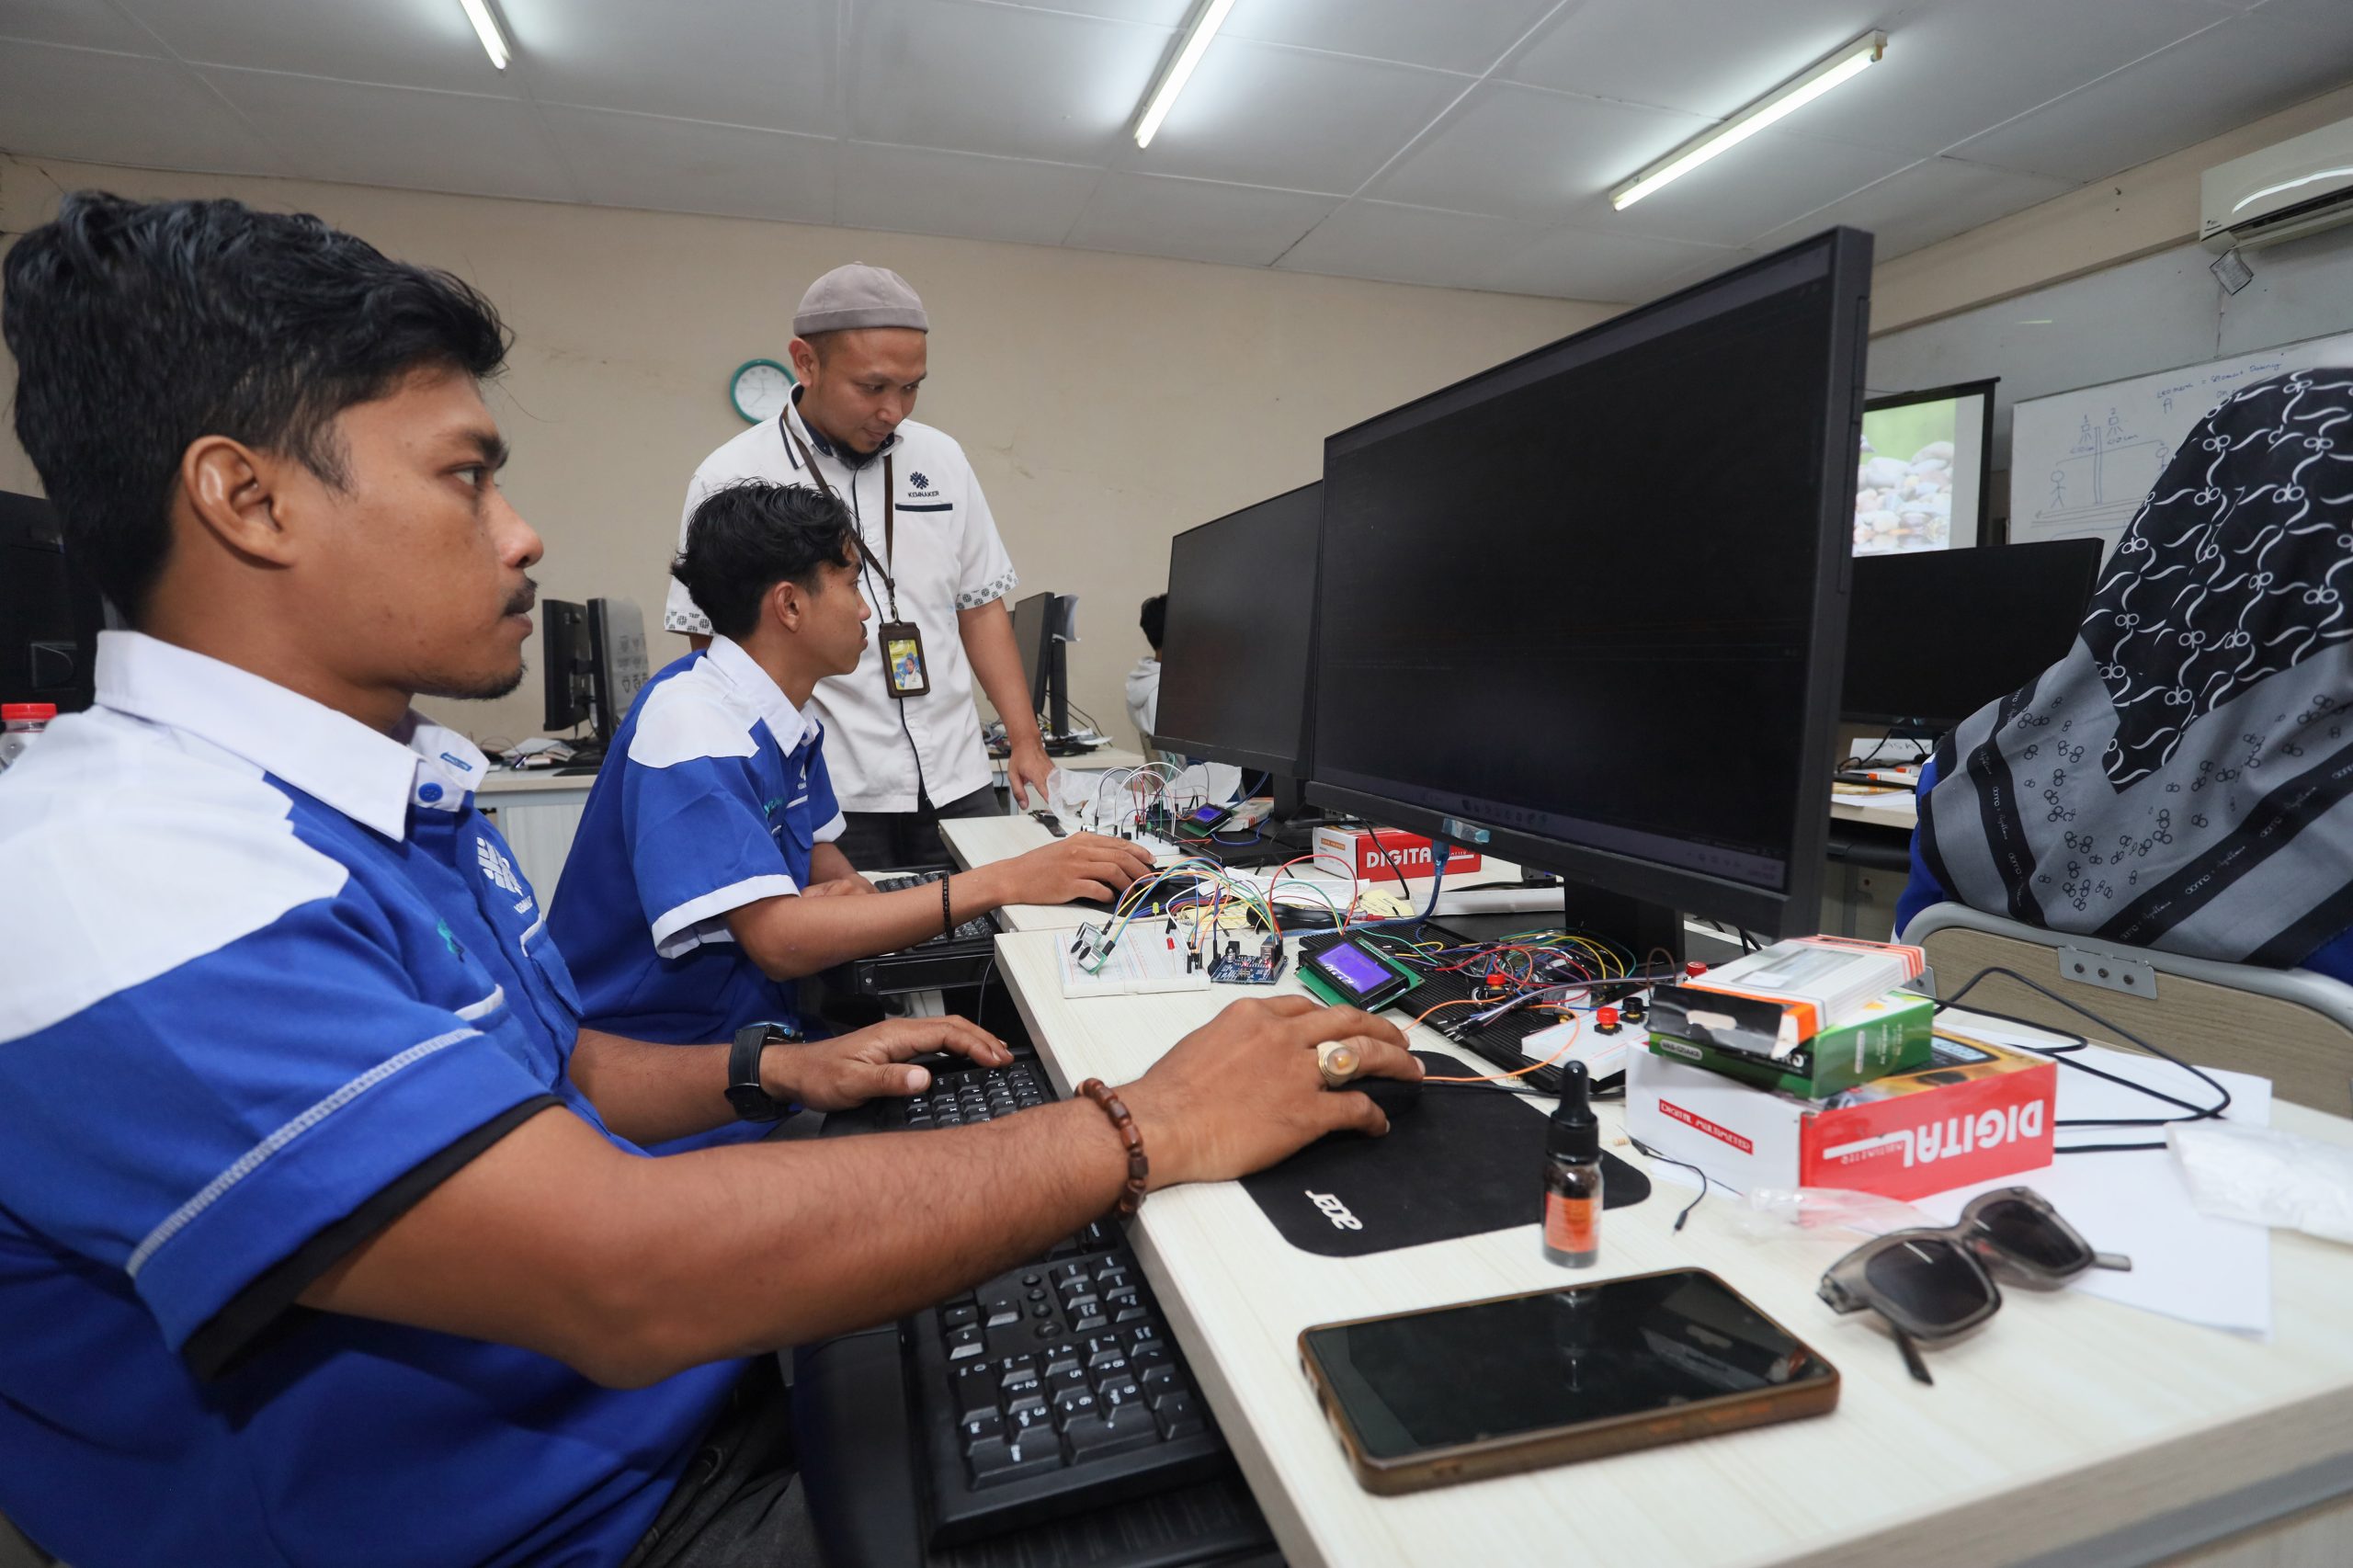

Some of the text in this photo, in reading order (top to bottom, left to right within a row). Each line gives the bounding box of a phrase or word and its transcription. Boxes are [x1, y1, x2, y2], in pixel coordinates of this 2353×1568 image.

[1823, 1099, 2044, 1167] DIGITAL
[1103, 1334, 1115, 1342] 7
[1061, 1345, 1073, 1353] 4
[973, 1363, 986, 1372] 0
[1112, 1359, 1125, 1369] 8
[1069, 1369, 1083, 1379] 5
[1025, 1380, 1039, 1390] 2
[1123, 1384, 1136, 1394] 9
[1078, 1395, 1092, 1406] 6
[1033, 1406, 1047, 1416] 3
